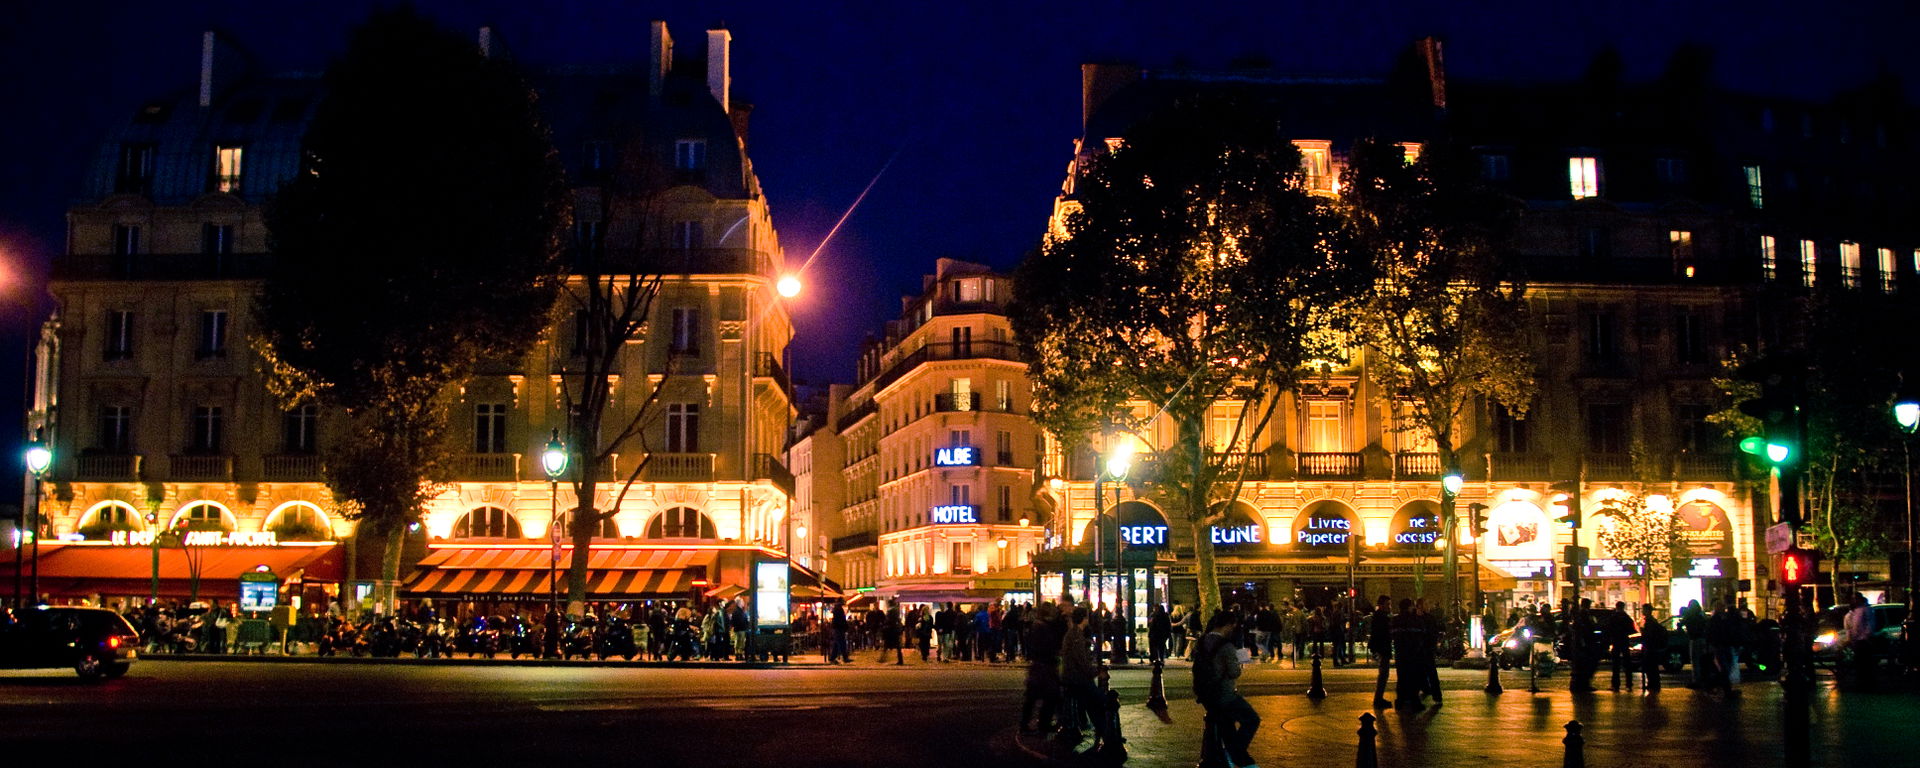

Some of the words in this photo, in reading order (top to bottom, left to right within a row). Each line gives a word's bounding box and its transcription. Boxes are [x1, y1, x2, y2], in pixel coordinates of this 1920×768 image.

[937, 447, 972, 465] ALBE
[933, 505, 977, 523] HOTEL
[1308, 517, 1351, 530] Livres
[112, 530, 127, 546] LE
[1297, 530, 1352, 546] Papeter
